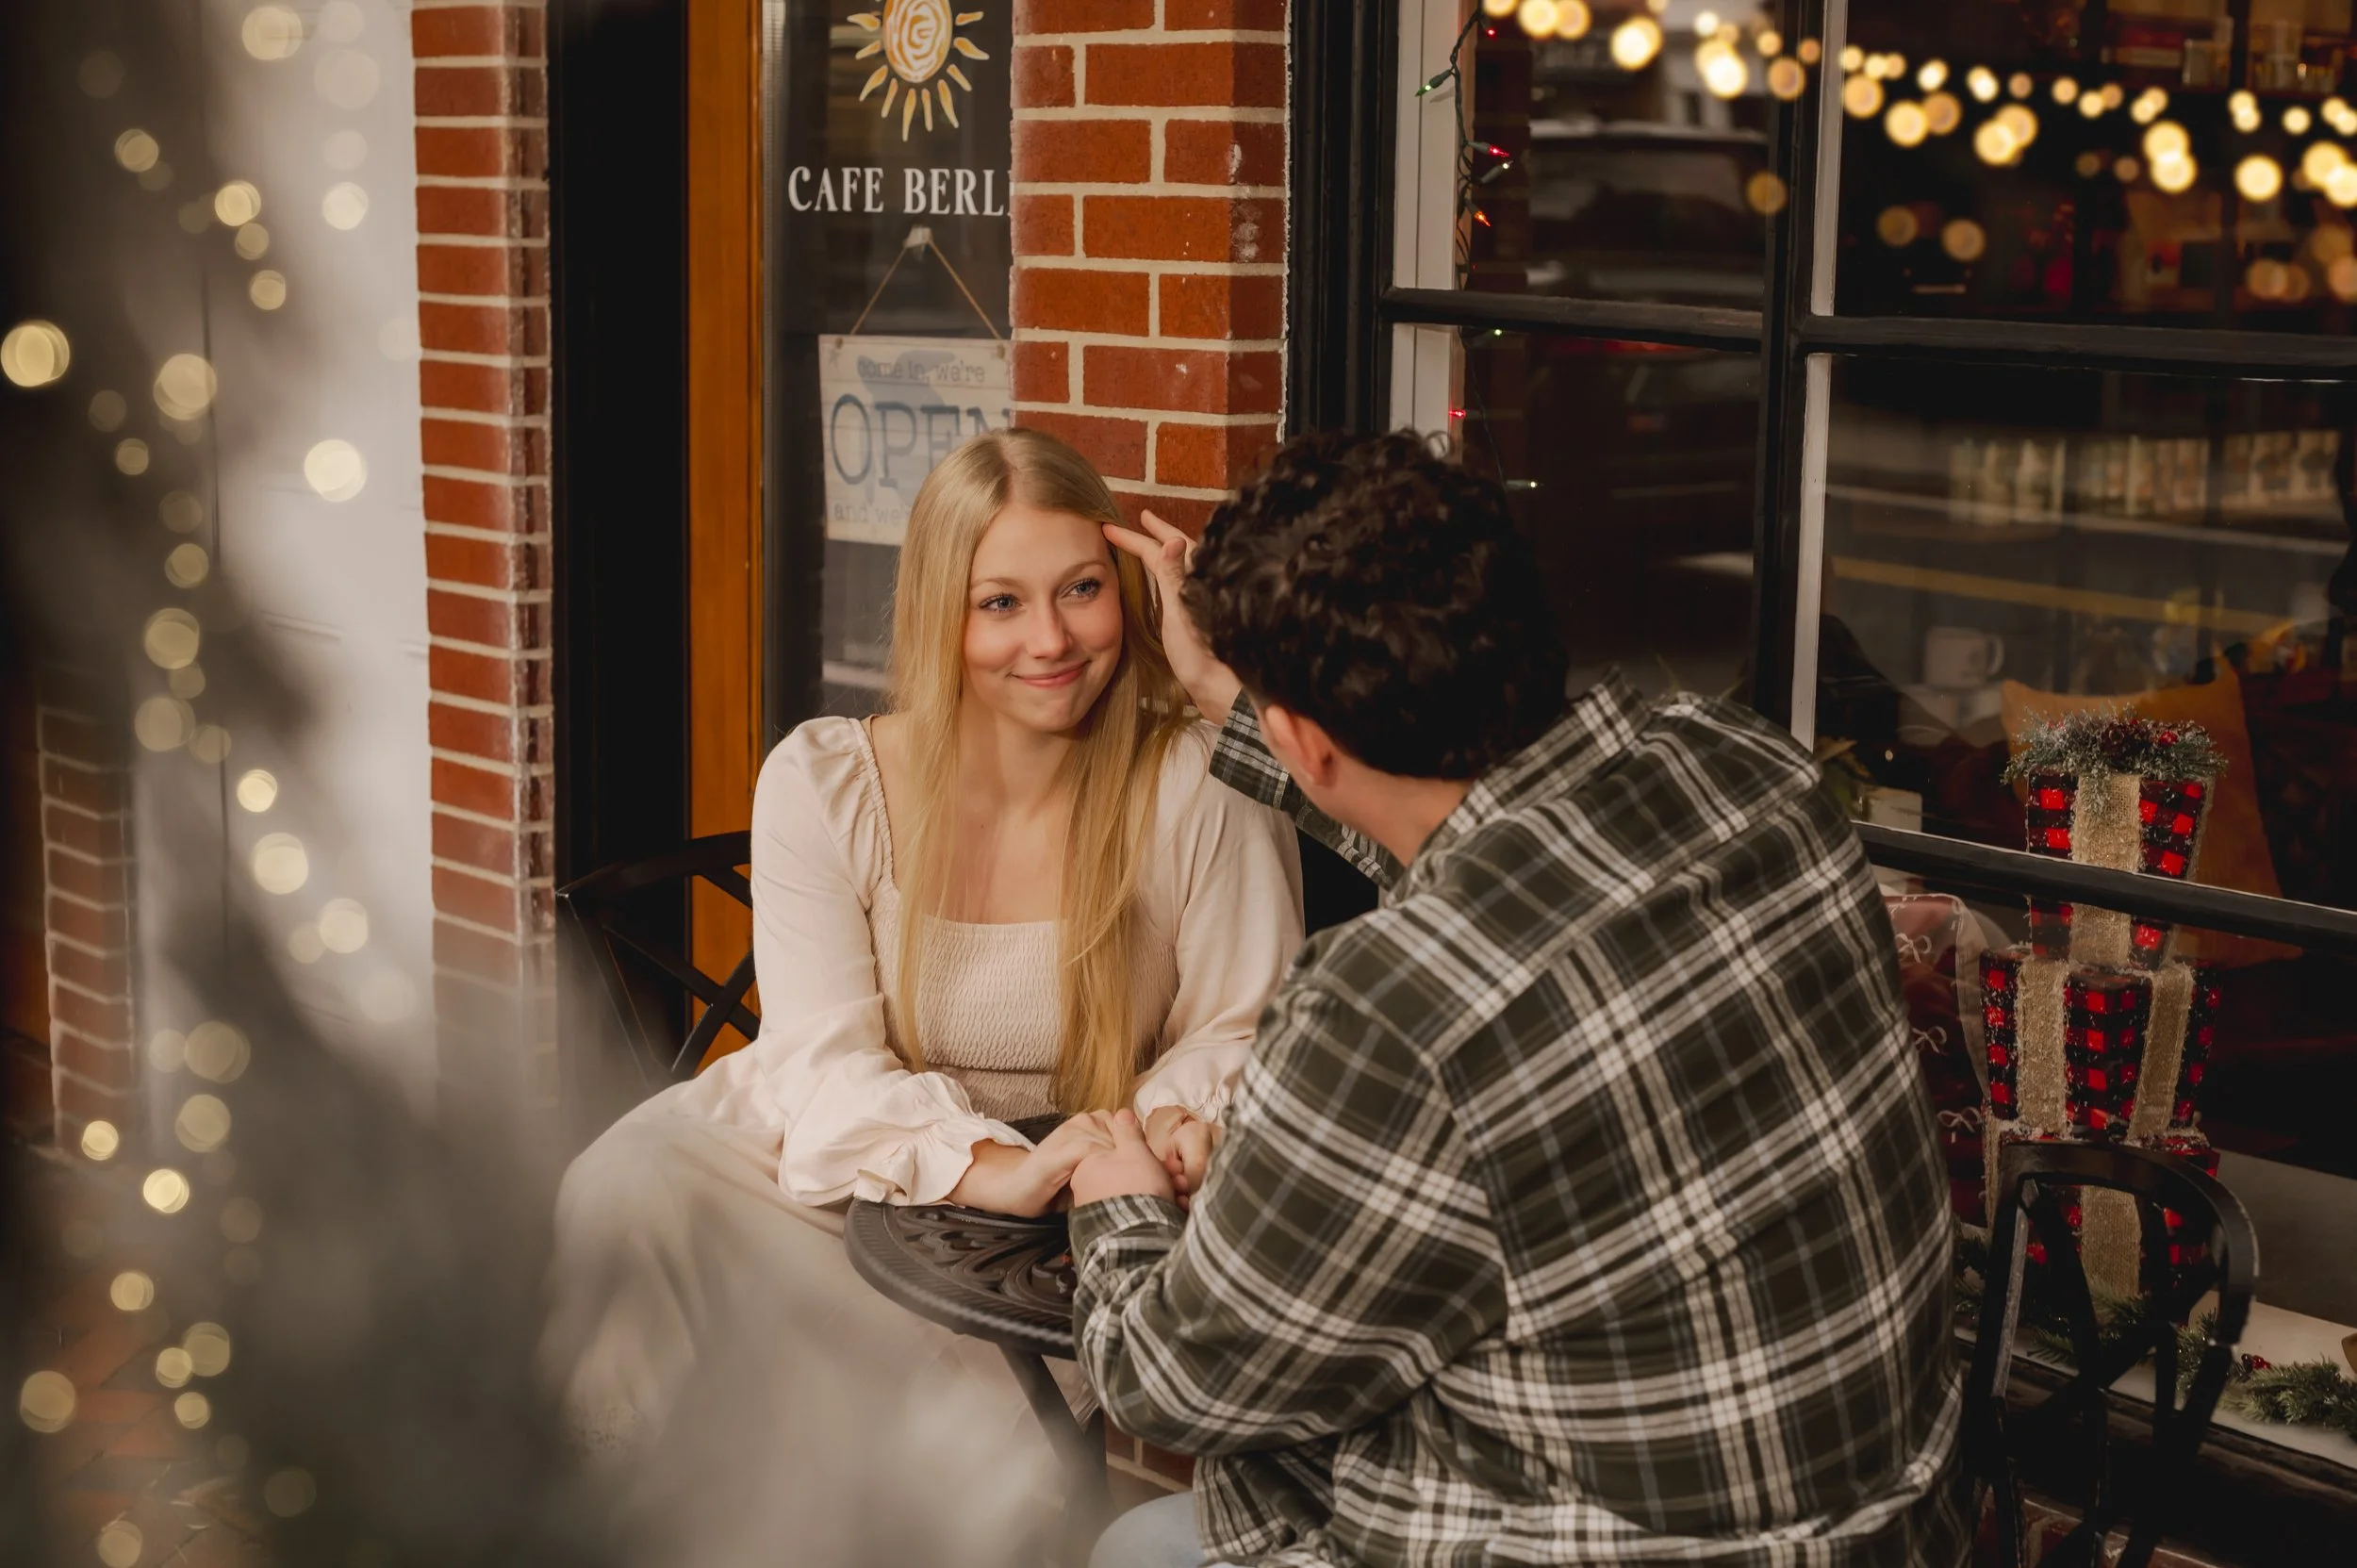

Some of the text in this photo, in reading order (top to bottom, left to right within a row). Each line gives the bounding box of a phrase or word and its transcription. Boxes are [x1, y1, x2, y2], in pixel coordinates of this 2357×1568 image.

[788, 165, 1012, 217] CAFE BERL
[859, 360, 903, 379] come
[934, 359, 986, 382] we're
